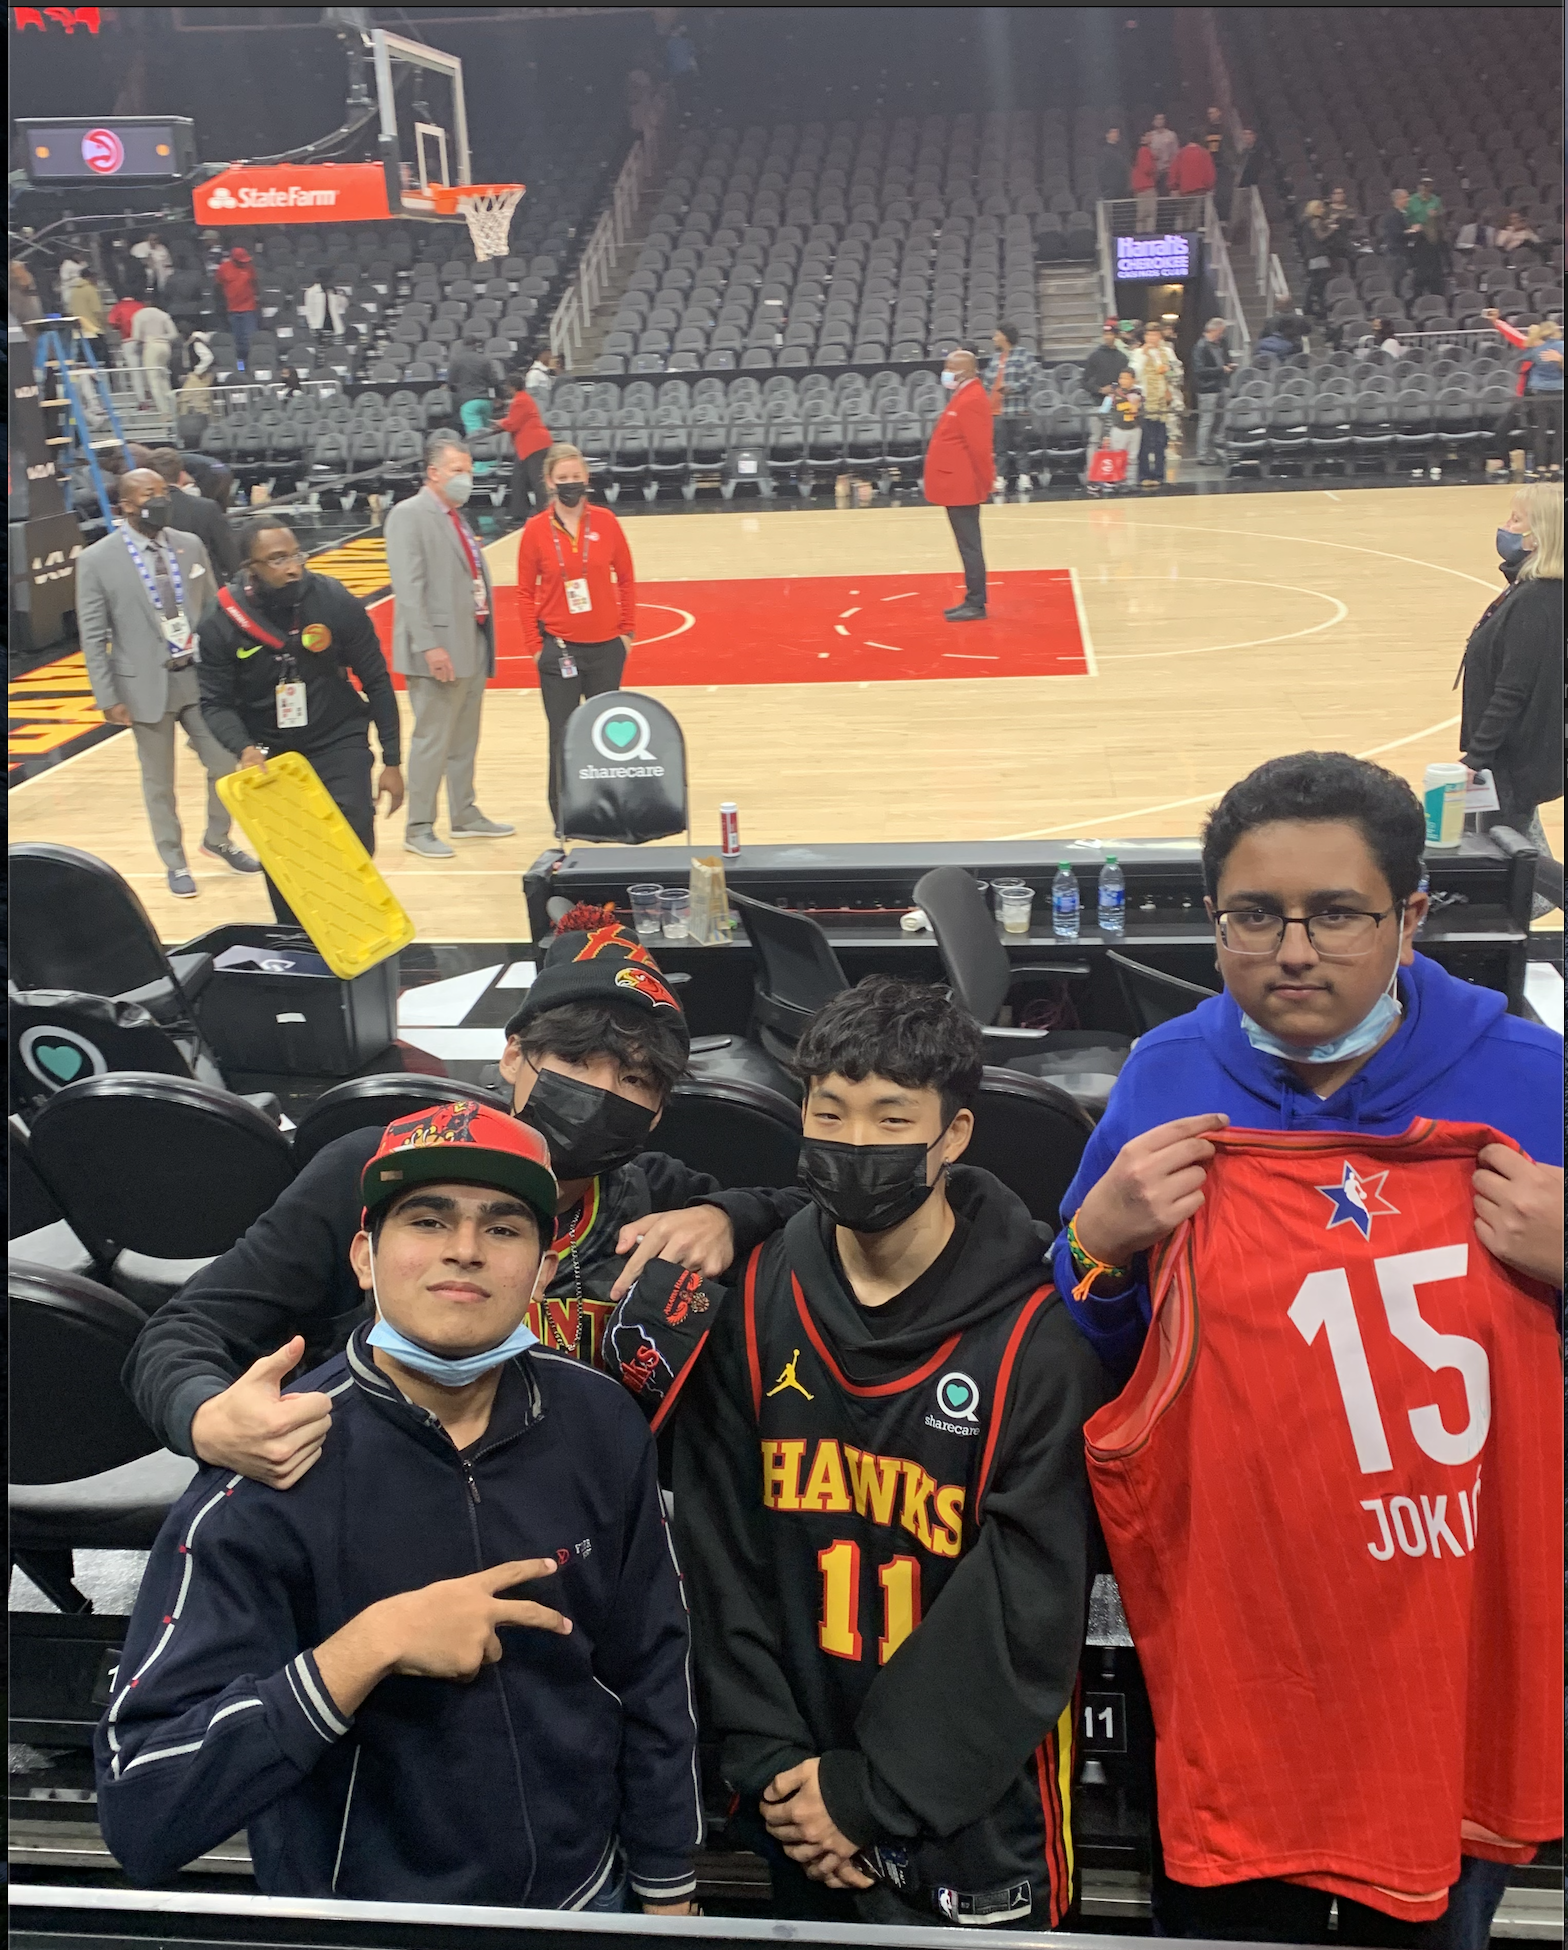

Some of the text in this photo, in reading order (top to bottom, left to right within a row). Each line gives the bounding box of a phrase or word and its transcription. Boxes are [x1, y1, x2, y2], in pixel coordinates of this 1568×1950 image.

[579, 764, 665, 780] sharecare
[1287, 1243, 1492, 1474] 15
[924, 1414, 981, 1437] sharecare
[761, 1438, 967, 1559] HAWKS
[818, 1539, 922, 1667] 11
[1084, 1706, 1114, 1739] 11
